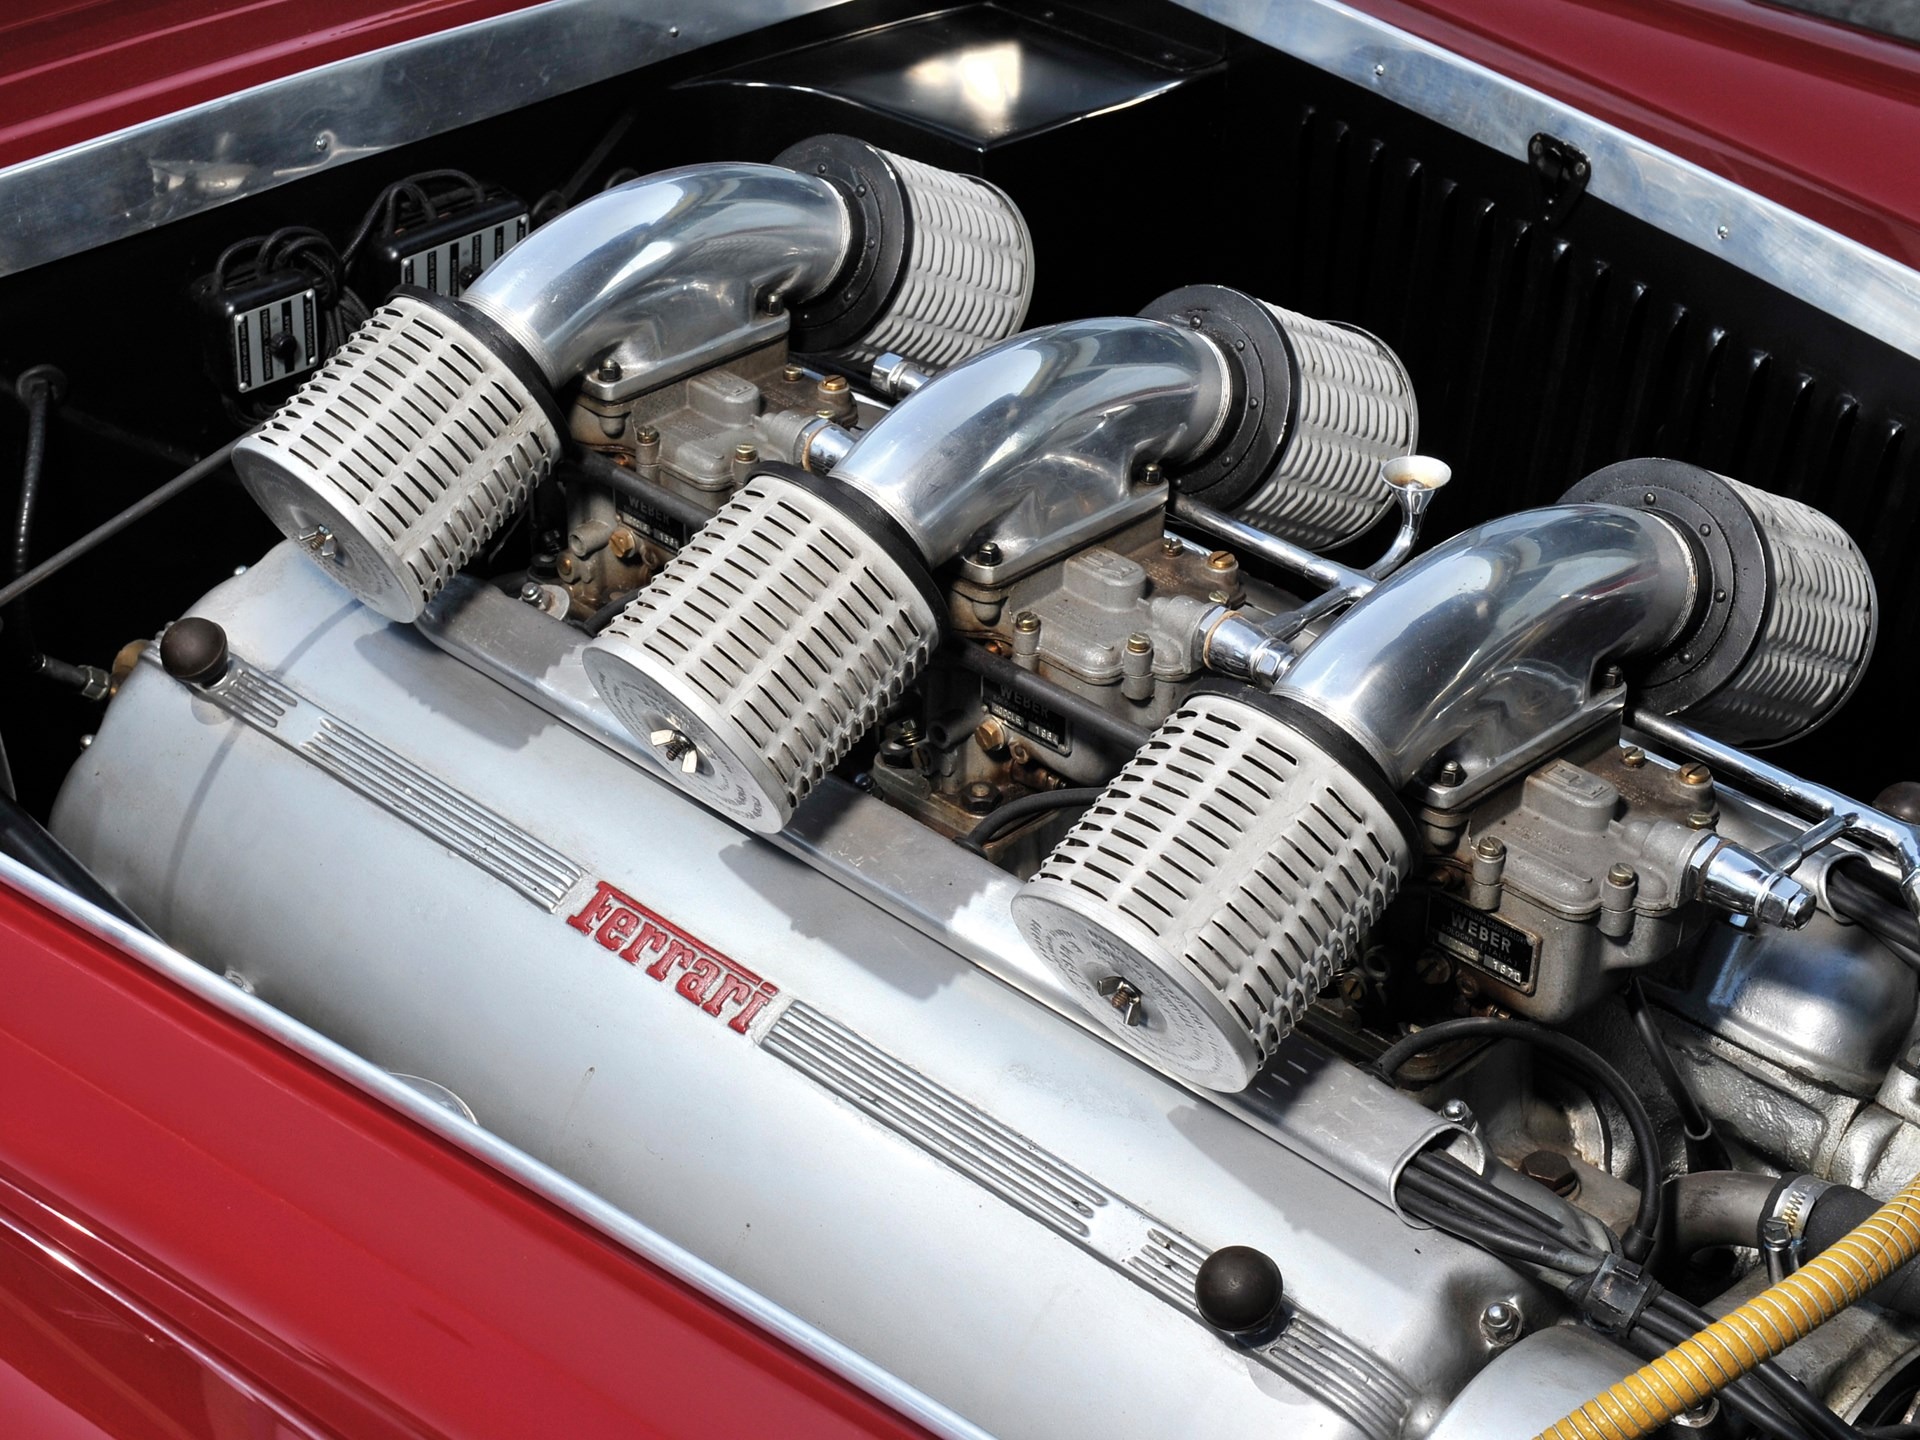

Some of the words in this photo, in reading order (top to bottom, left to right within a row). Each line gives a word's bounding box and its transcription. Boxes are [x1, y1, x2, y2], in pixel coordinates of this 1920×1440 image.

[628, 495, 670, 525] WEBER
[1000, 685, 1049, 718] WEBER
[1451, 911, 1511, 953] WEBER
[566, 880, 780, 1035] Ferrari
